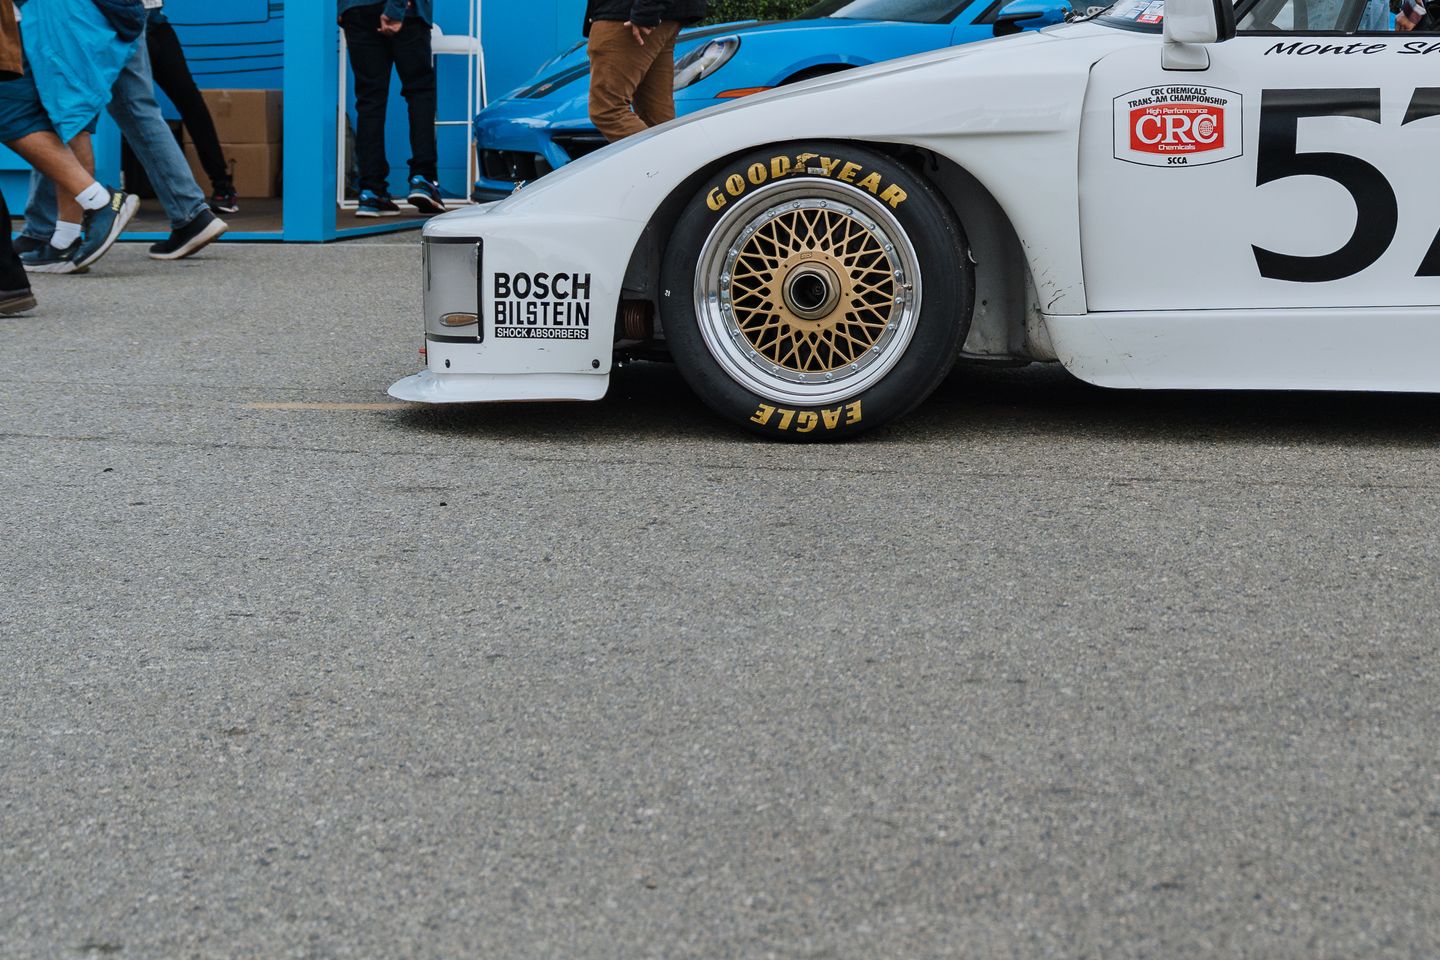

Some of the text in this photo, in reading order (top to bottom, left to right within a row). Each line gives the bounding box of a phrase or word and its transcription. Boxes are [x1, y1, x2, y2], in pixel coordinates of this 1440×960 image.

[1264, 42, 1387, 56] Monte
[1128, 95, 1228, 108] TRANS-AM CHAMPIONSHIP
[1166, 87, 1207, 96] CHEMICALS
[1135, 114, 1218, 144] CRC
[494, 272, 591, 300] BOSCH
[494, 300, 590, 326] BILSTEIN
[497, 327, 587, 339] SHOCK ABSORBERS
[750, 399, 862, 433] EAGLE
